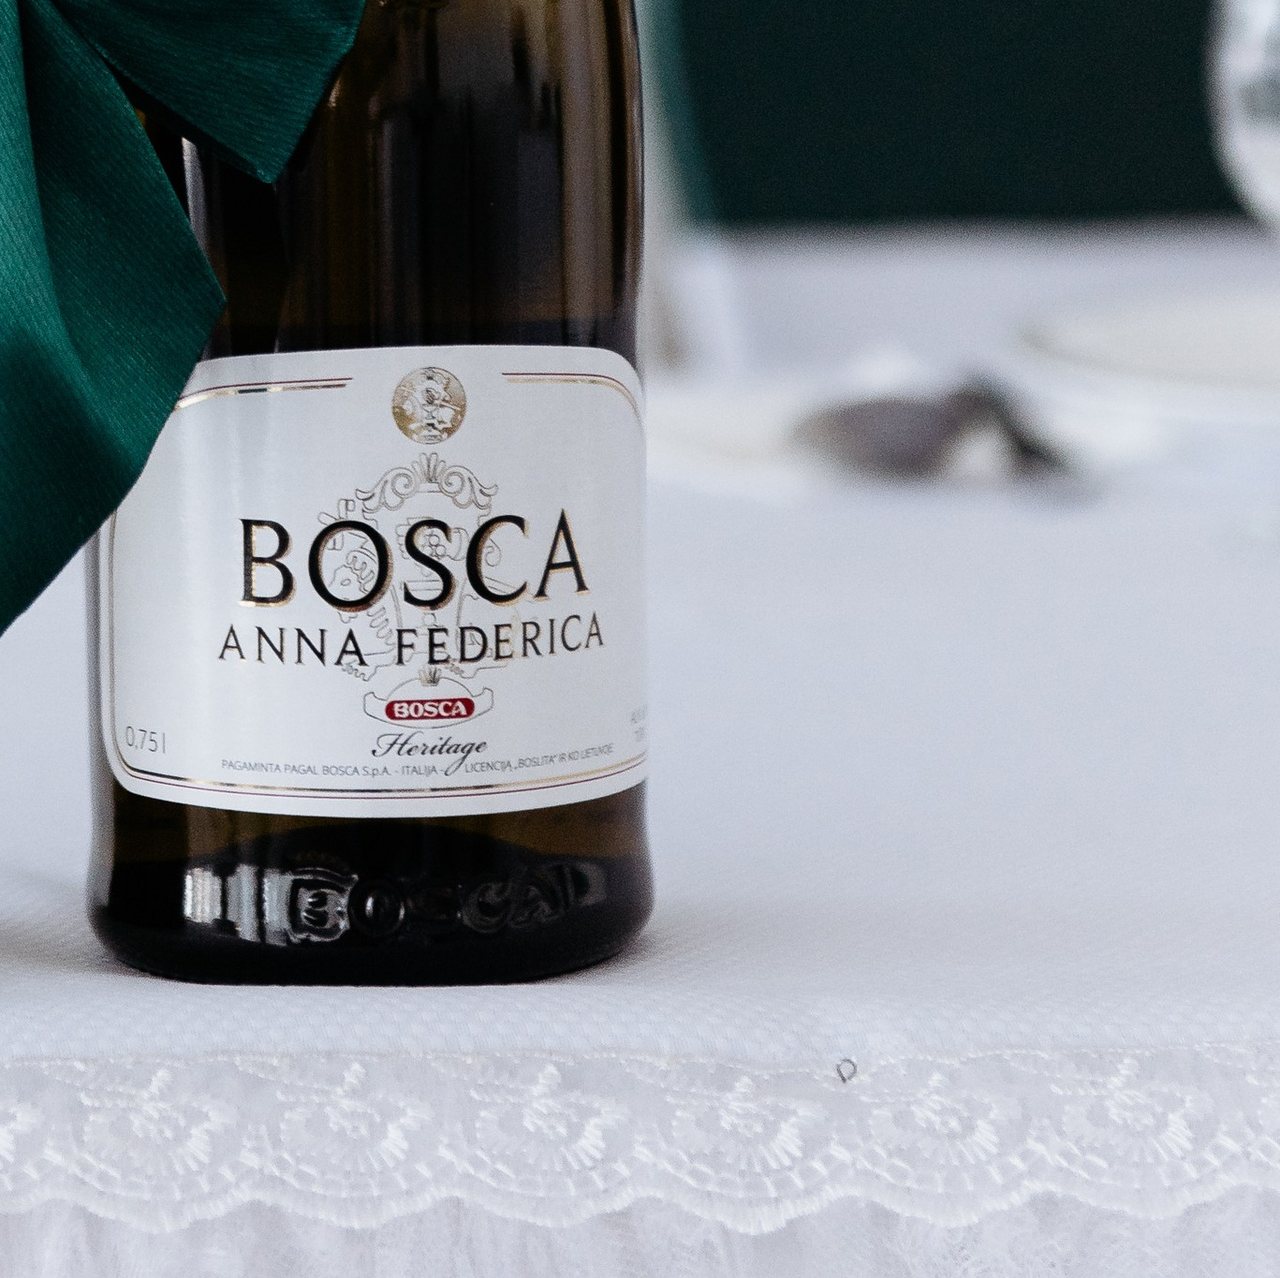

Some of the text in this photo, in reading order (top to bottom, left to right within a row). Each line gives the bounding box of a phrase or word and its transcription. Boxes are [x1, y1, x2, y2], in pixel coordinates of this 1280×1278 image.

[238, 508, 590, 612] BOSCA
[218, 611, 604, 667] ANNA FEDERICA
[393, 700, 468, 718] BOSCA
[125, 725, 158, 753] 0,75
[371, 730, 488, 776] Heritage
[221, 759, 281, 774] PAGAMINTA
[284, 763, 318, 775] PAGAL
[323, 765, 360, 776] BOSCA
